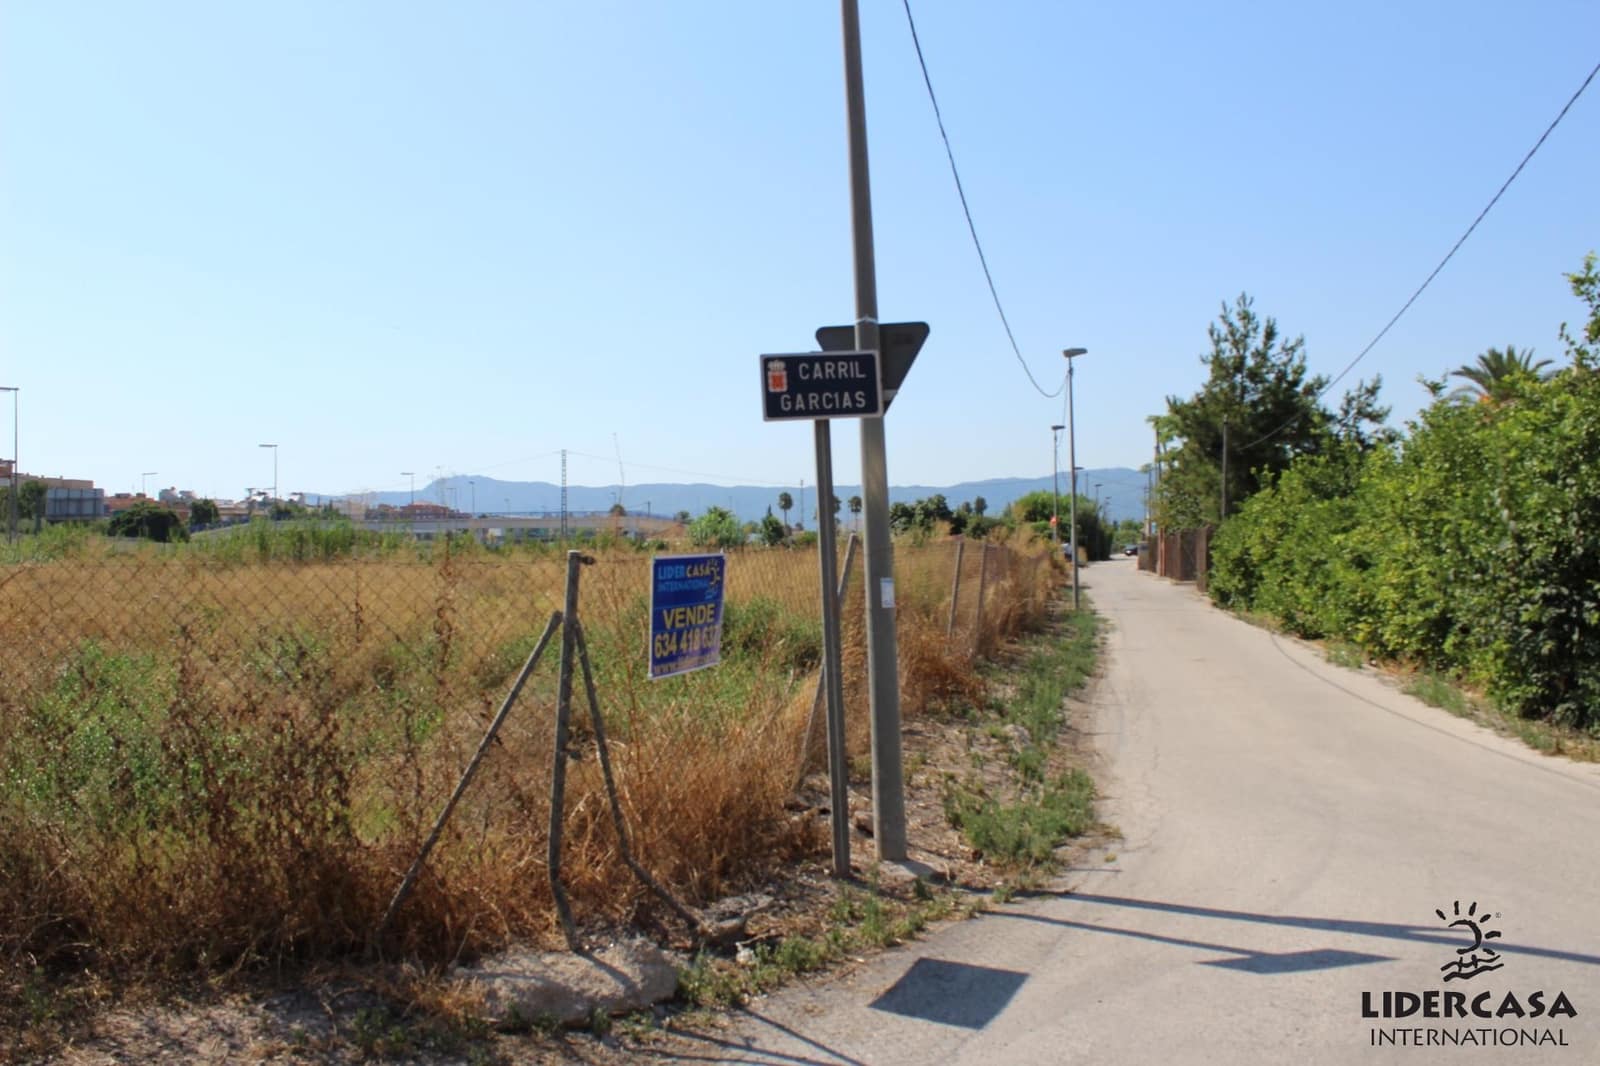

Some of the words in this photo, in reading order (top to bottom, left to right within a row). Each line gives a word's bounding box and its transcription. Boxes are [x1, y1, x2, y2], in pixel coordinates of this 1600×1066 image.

[798, 361, 867, 380] CARRIL
[780, 391, 867, 412] GARCIAS
[663, 604, 715, 629] VENDE
[654, 632, 677, 658] 634
